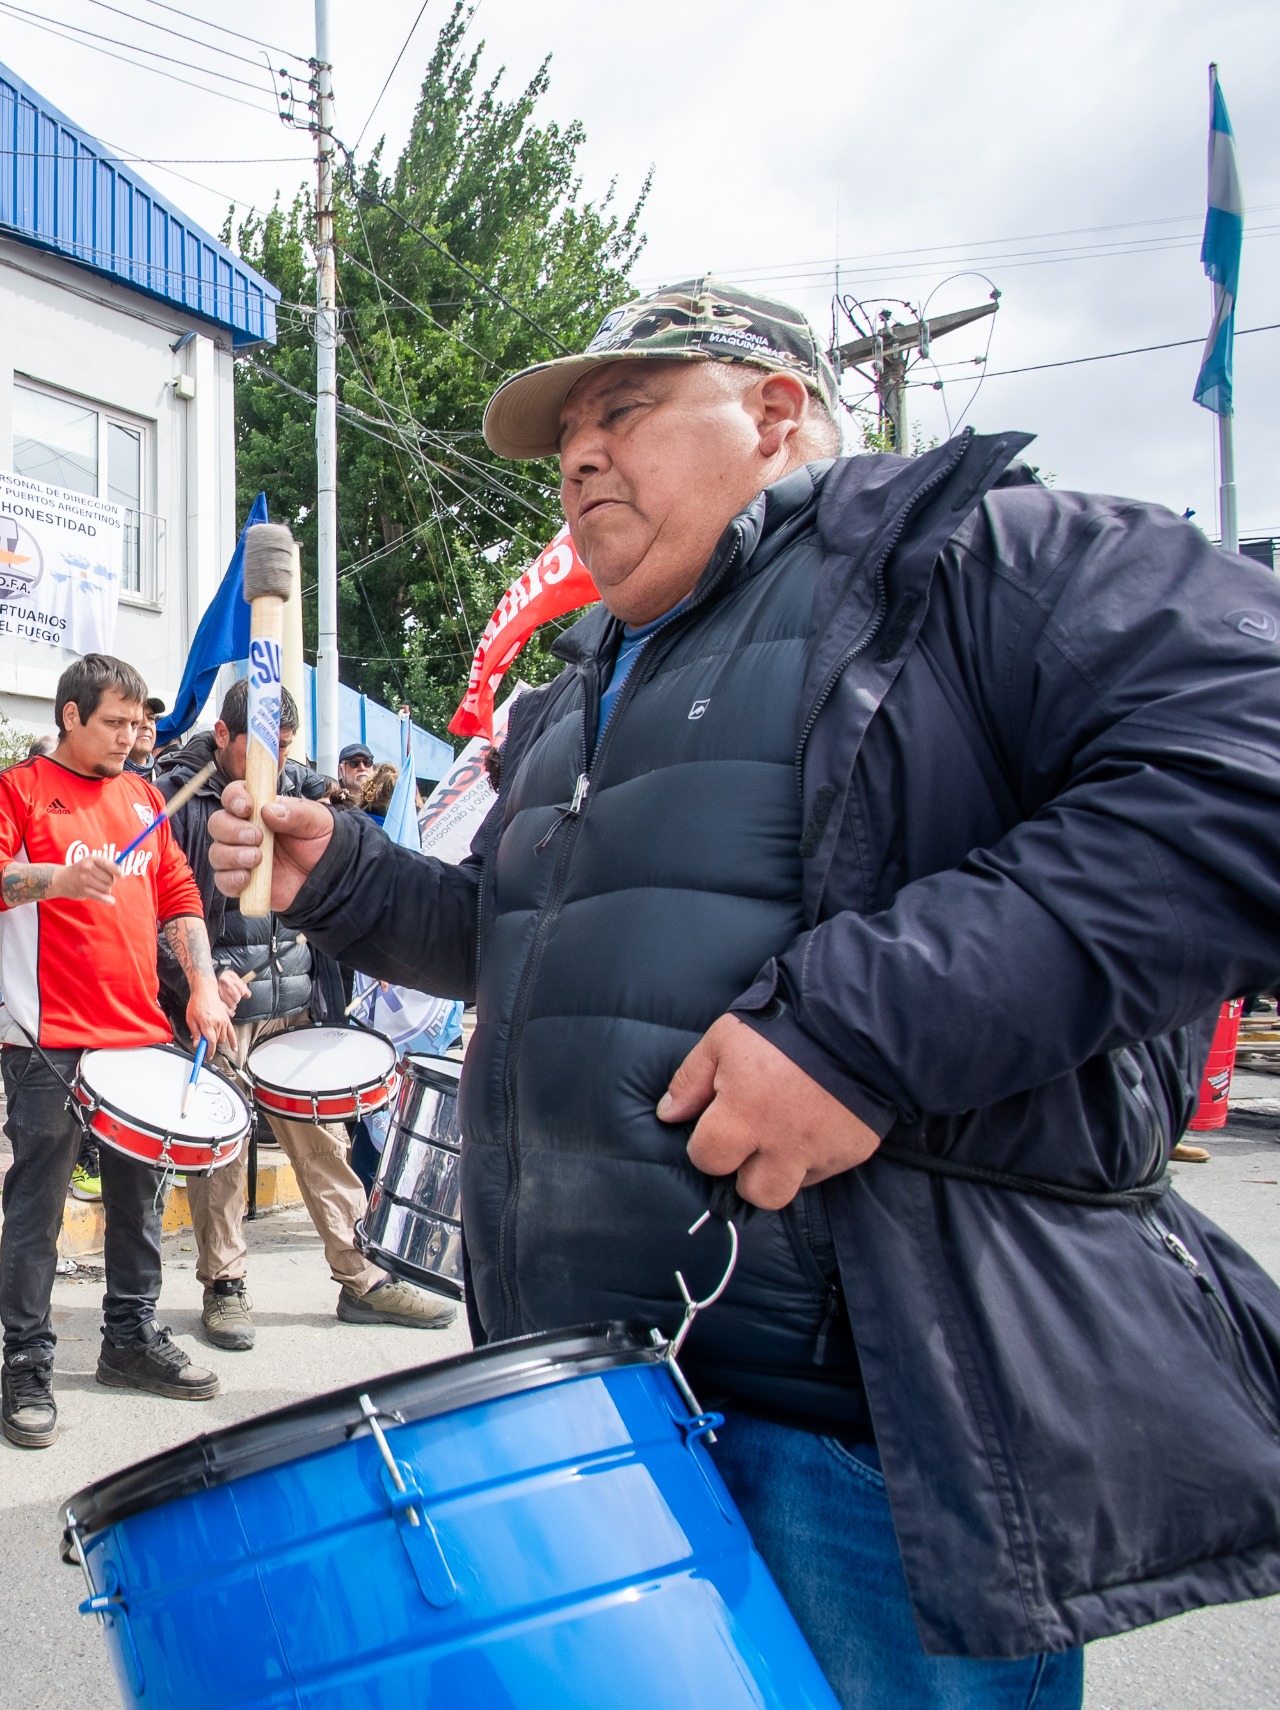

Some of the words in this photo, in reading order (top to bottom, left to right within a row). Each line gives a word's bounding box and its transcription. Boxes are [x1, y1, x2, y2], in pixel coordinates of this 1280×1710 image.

[46, 487, 60, 497] DE
[5, 486, 55, 508] PUERTOS
[58, 502, 120, 529] ARGENTINOS
[1, 501, 97, 537] HONESTIDAD
[17, 624, 60, 643] FUEGO
[46, 807, 71, 815] adidas
